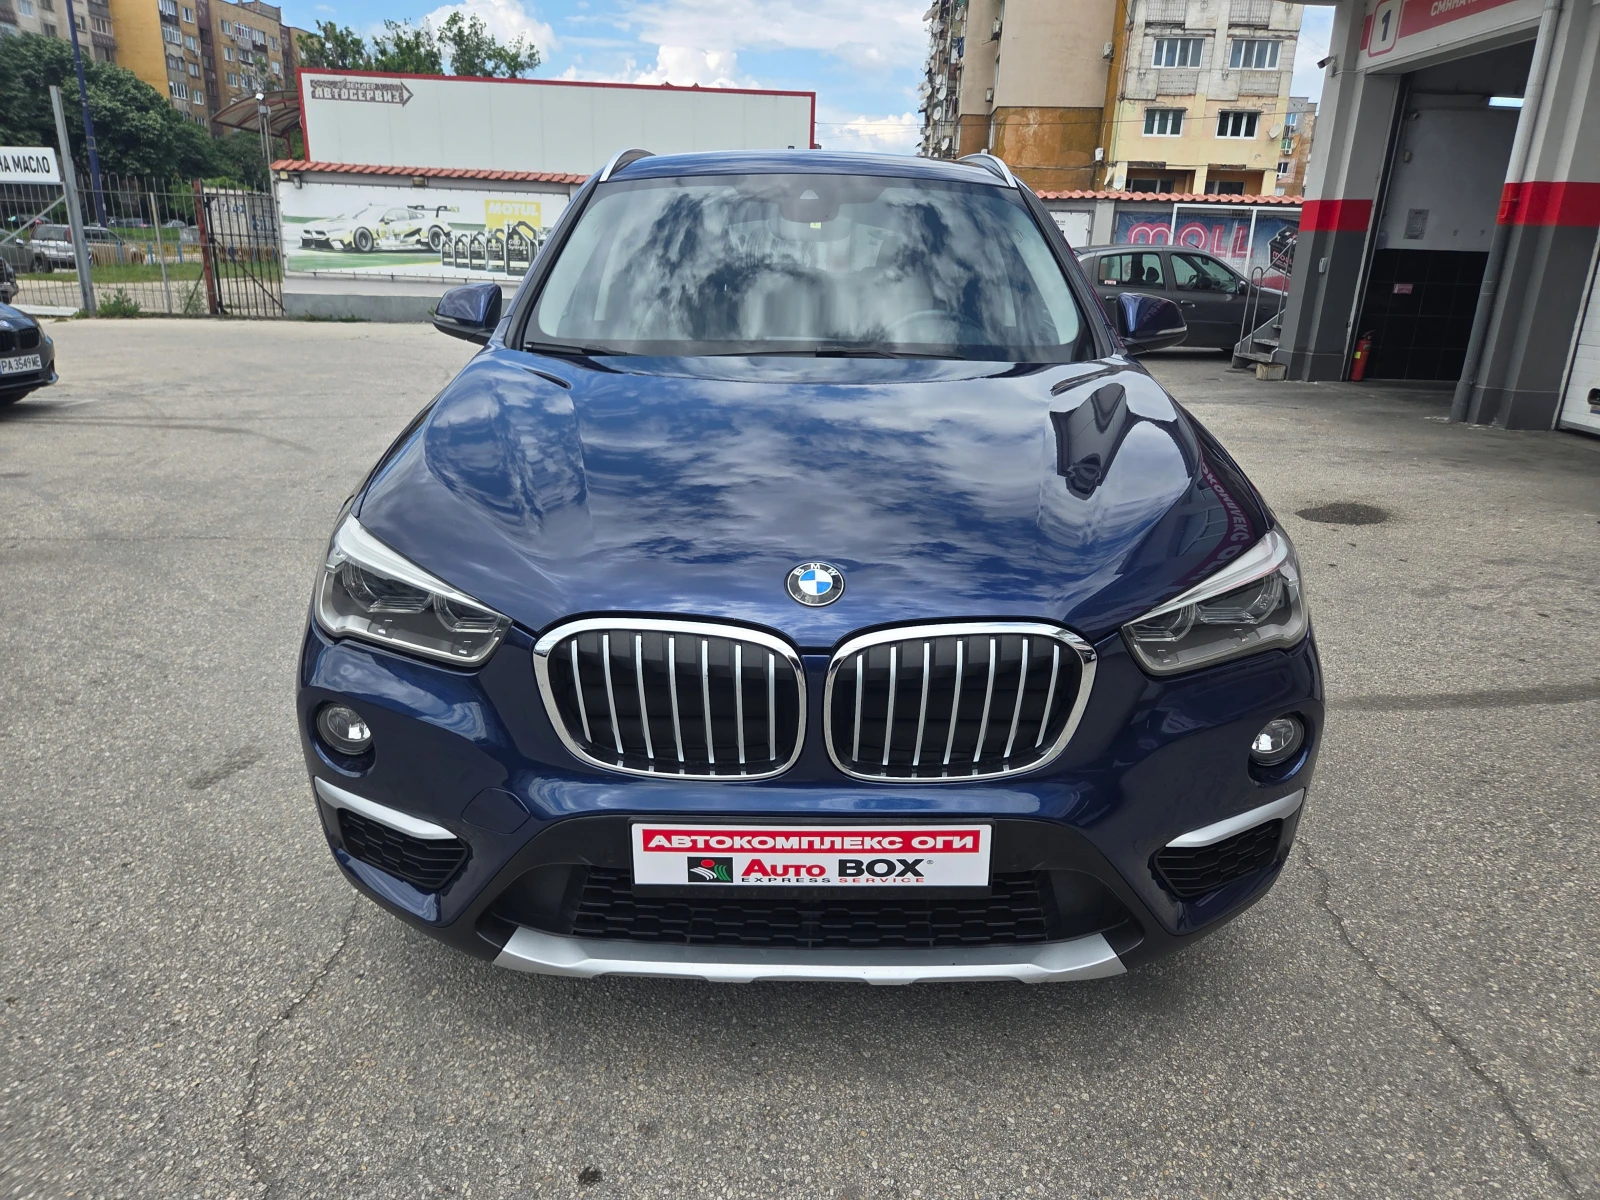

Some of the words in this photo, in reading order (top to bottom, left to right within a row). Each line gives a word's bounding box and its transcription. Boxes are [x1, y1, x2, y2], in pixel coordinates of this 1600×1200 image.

[1381, 9, 1391, 42] 1
[314, 87, 401, 102] АВТОСЕРВИЗ
[11, 155, 50, 173] МАСЛО
[488, 201, 539, 217] MOTUL
[793, 563, 839, 576] BMW
[647, 834, 904, 850] АВТОКОМПЛЕКС
[909, 835, 975, 850] ОГИ
